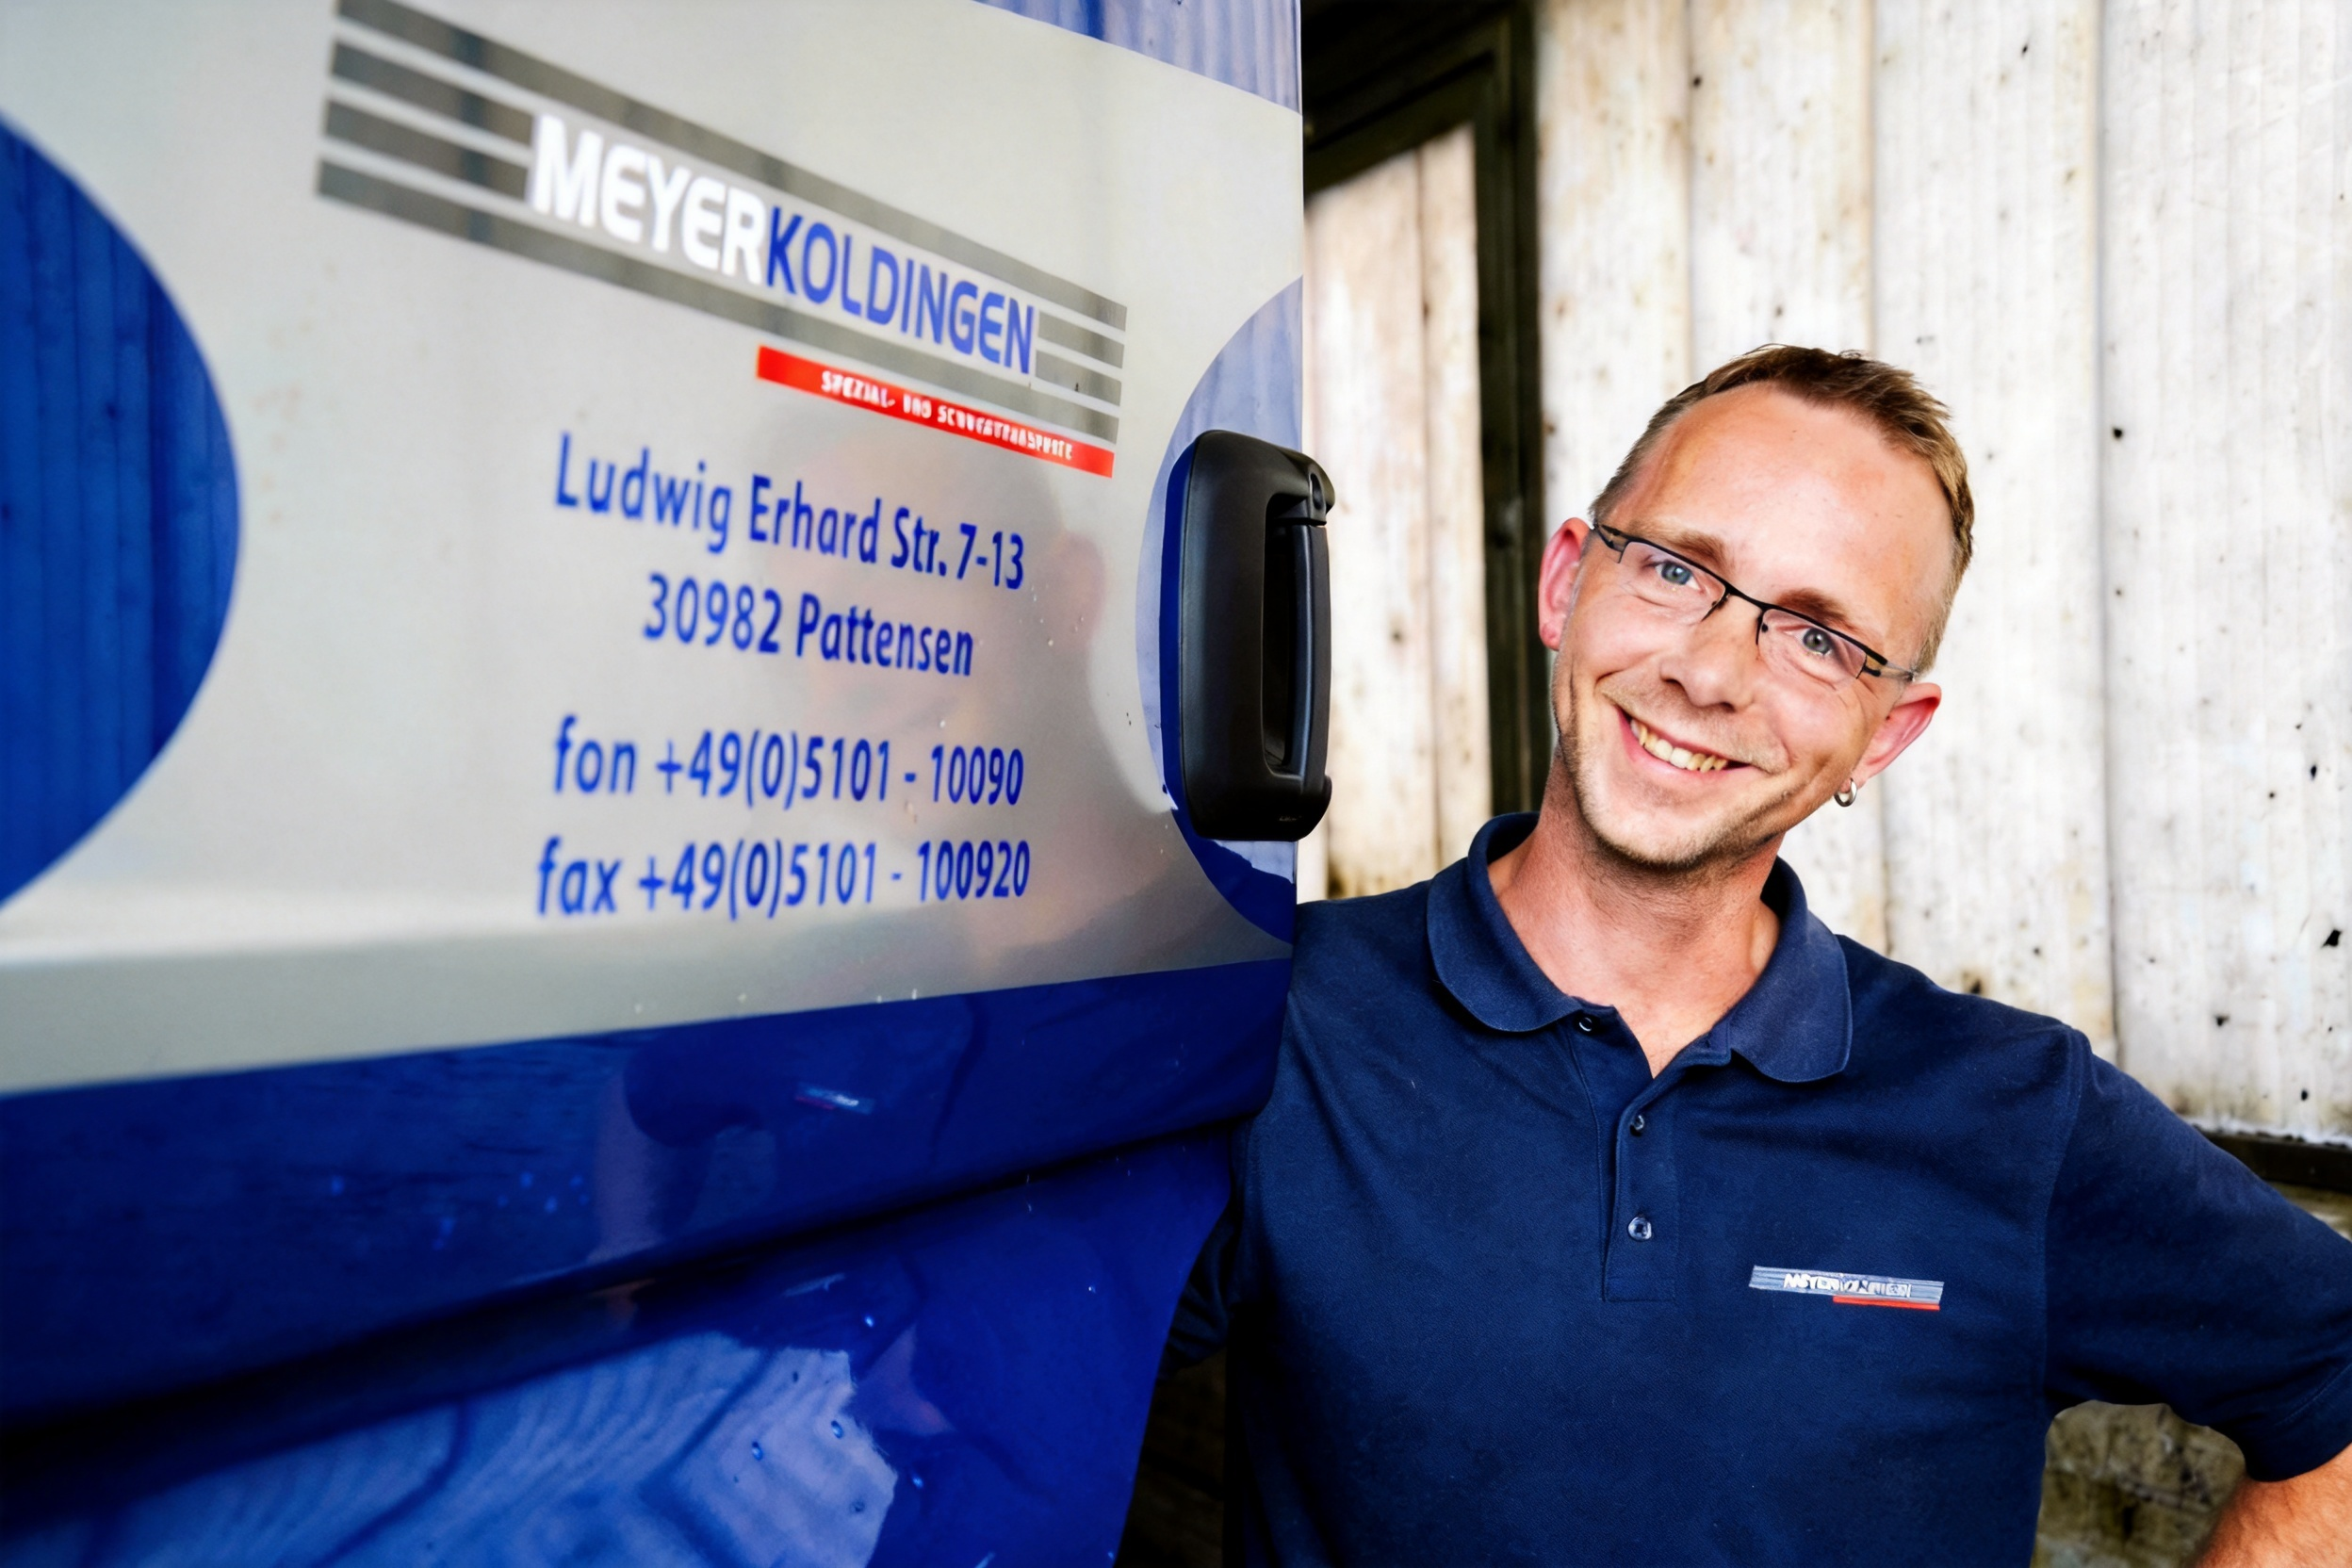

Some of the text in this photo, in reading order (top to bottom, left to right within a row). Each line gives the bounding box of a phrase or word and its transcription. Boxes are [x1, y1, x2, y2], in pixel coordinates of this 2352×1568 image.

[554, 432, 1025, 591] Ludwig Erhard Str. 7-13
[642, 572, 974, 677] 30982 Pattensen
[552, 714, 639, 794] fon
[655, 729, 890, 810] +49(0)5101
[929, 743, 1025, 807] 10090
[535, 835, 624, 917] fax
[637, 840, 877, 922] +49(0)5101
[916, 839, 1032, 903] 100920
